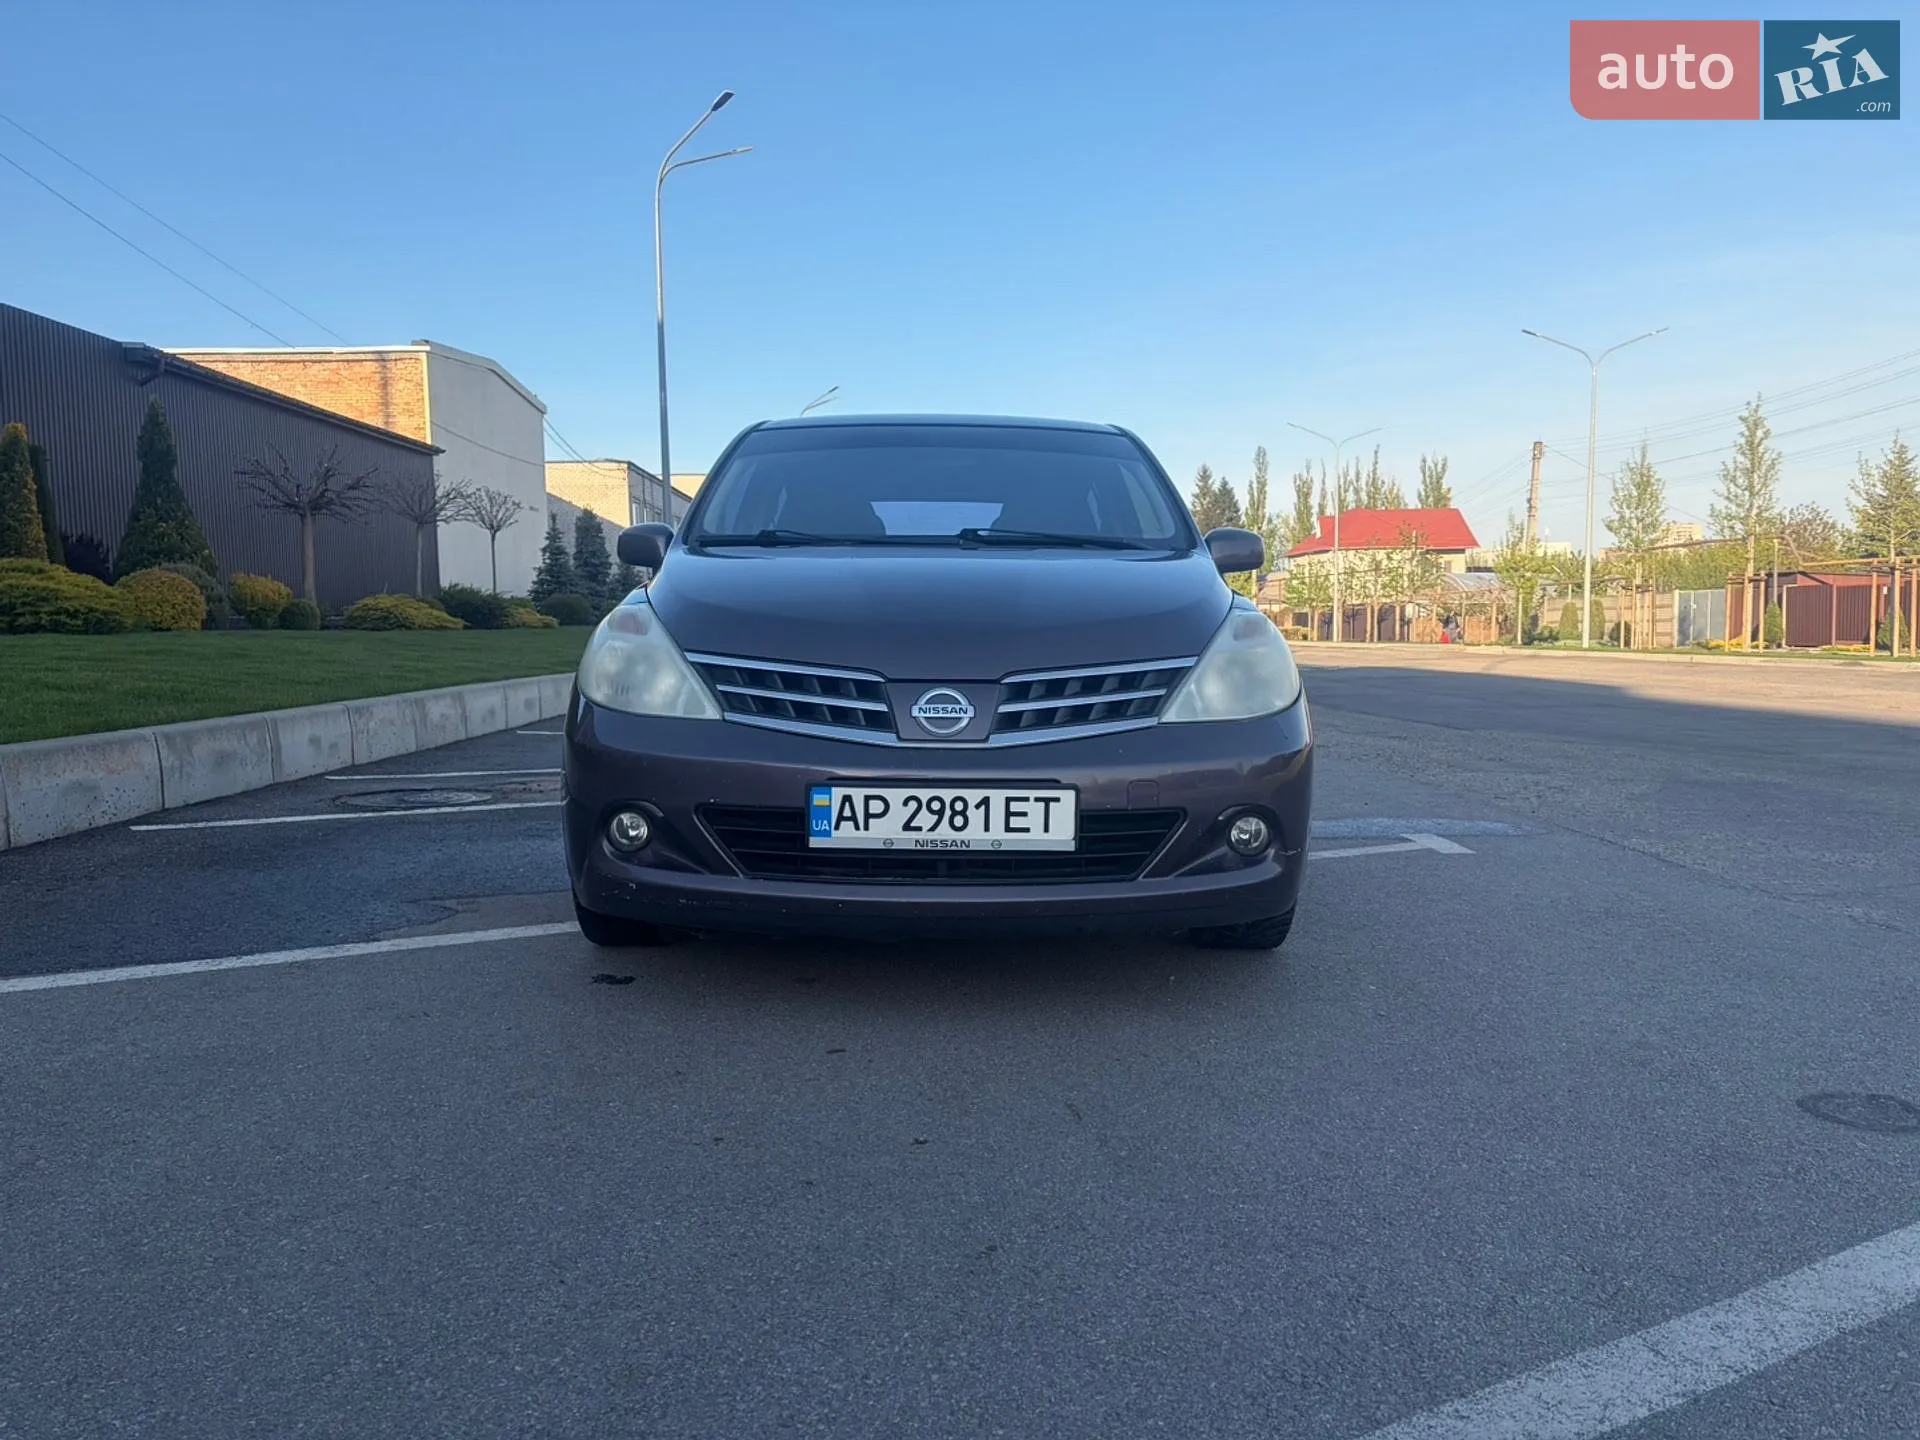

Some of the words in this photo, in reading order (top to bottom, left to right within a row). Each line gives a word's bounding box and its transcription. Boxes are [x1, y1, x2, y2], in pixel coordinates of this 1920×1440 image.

[918, 706, 968, 715] NISSAN
[833, 794, 890, 831] AP
[901, 795, 991, 833] 2981
[1004, 796, 1061, 833] ET
[812, 820, 830, 831] UA
[914, 838, 971, 849] NISSAN
